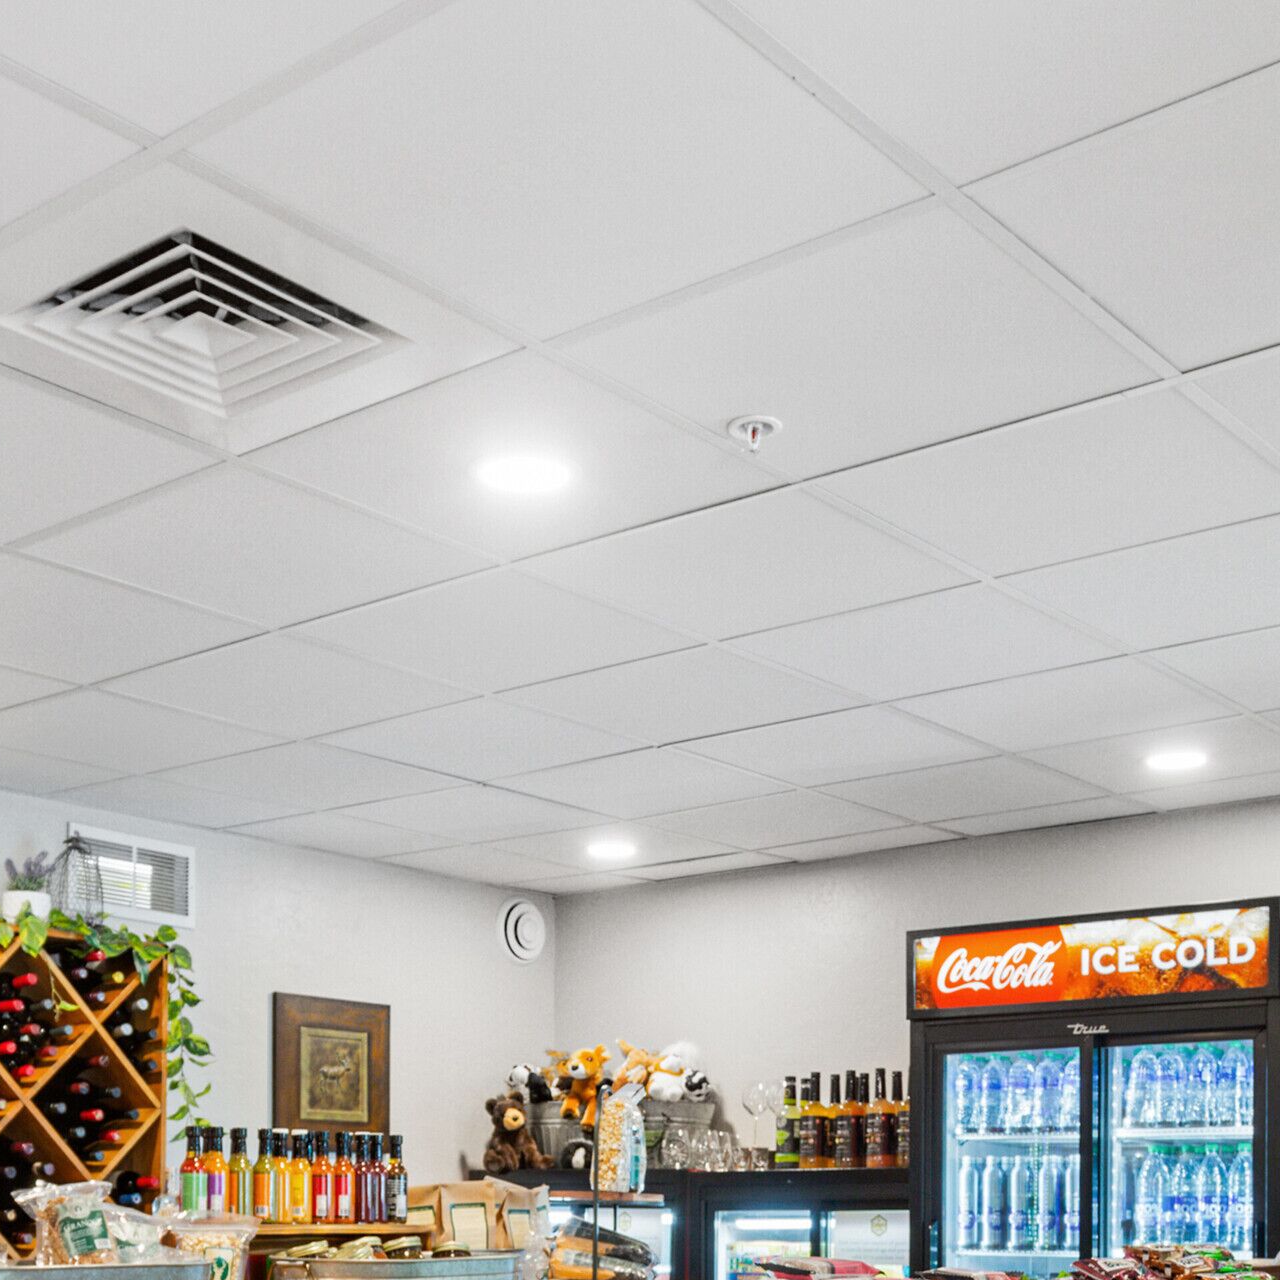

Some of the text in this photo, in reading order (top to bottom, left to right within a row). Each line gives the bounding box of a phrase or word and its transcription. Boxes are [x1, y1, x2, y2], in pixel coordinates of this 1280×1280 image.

[936, 935, 1257, 994] Coca-Cola ICE COLD
